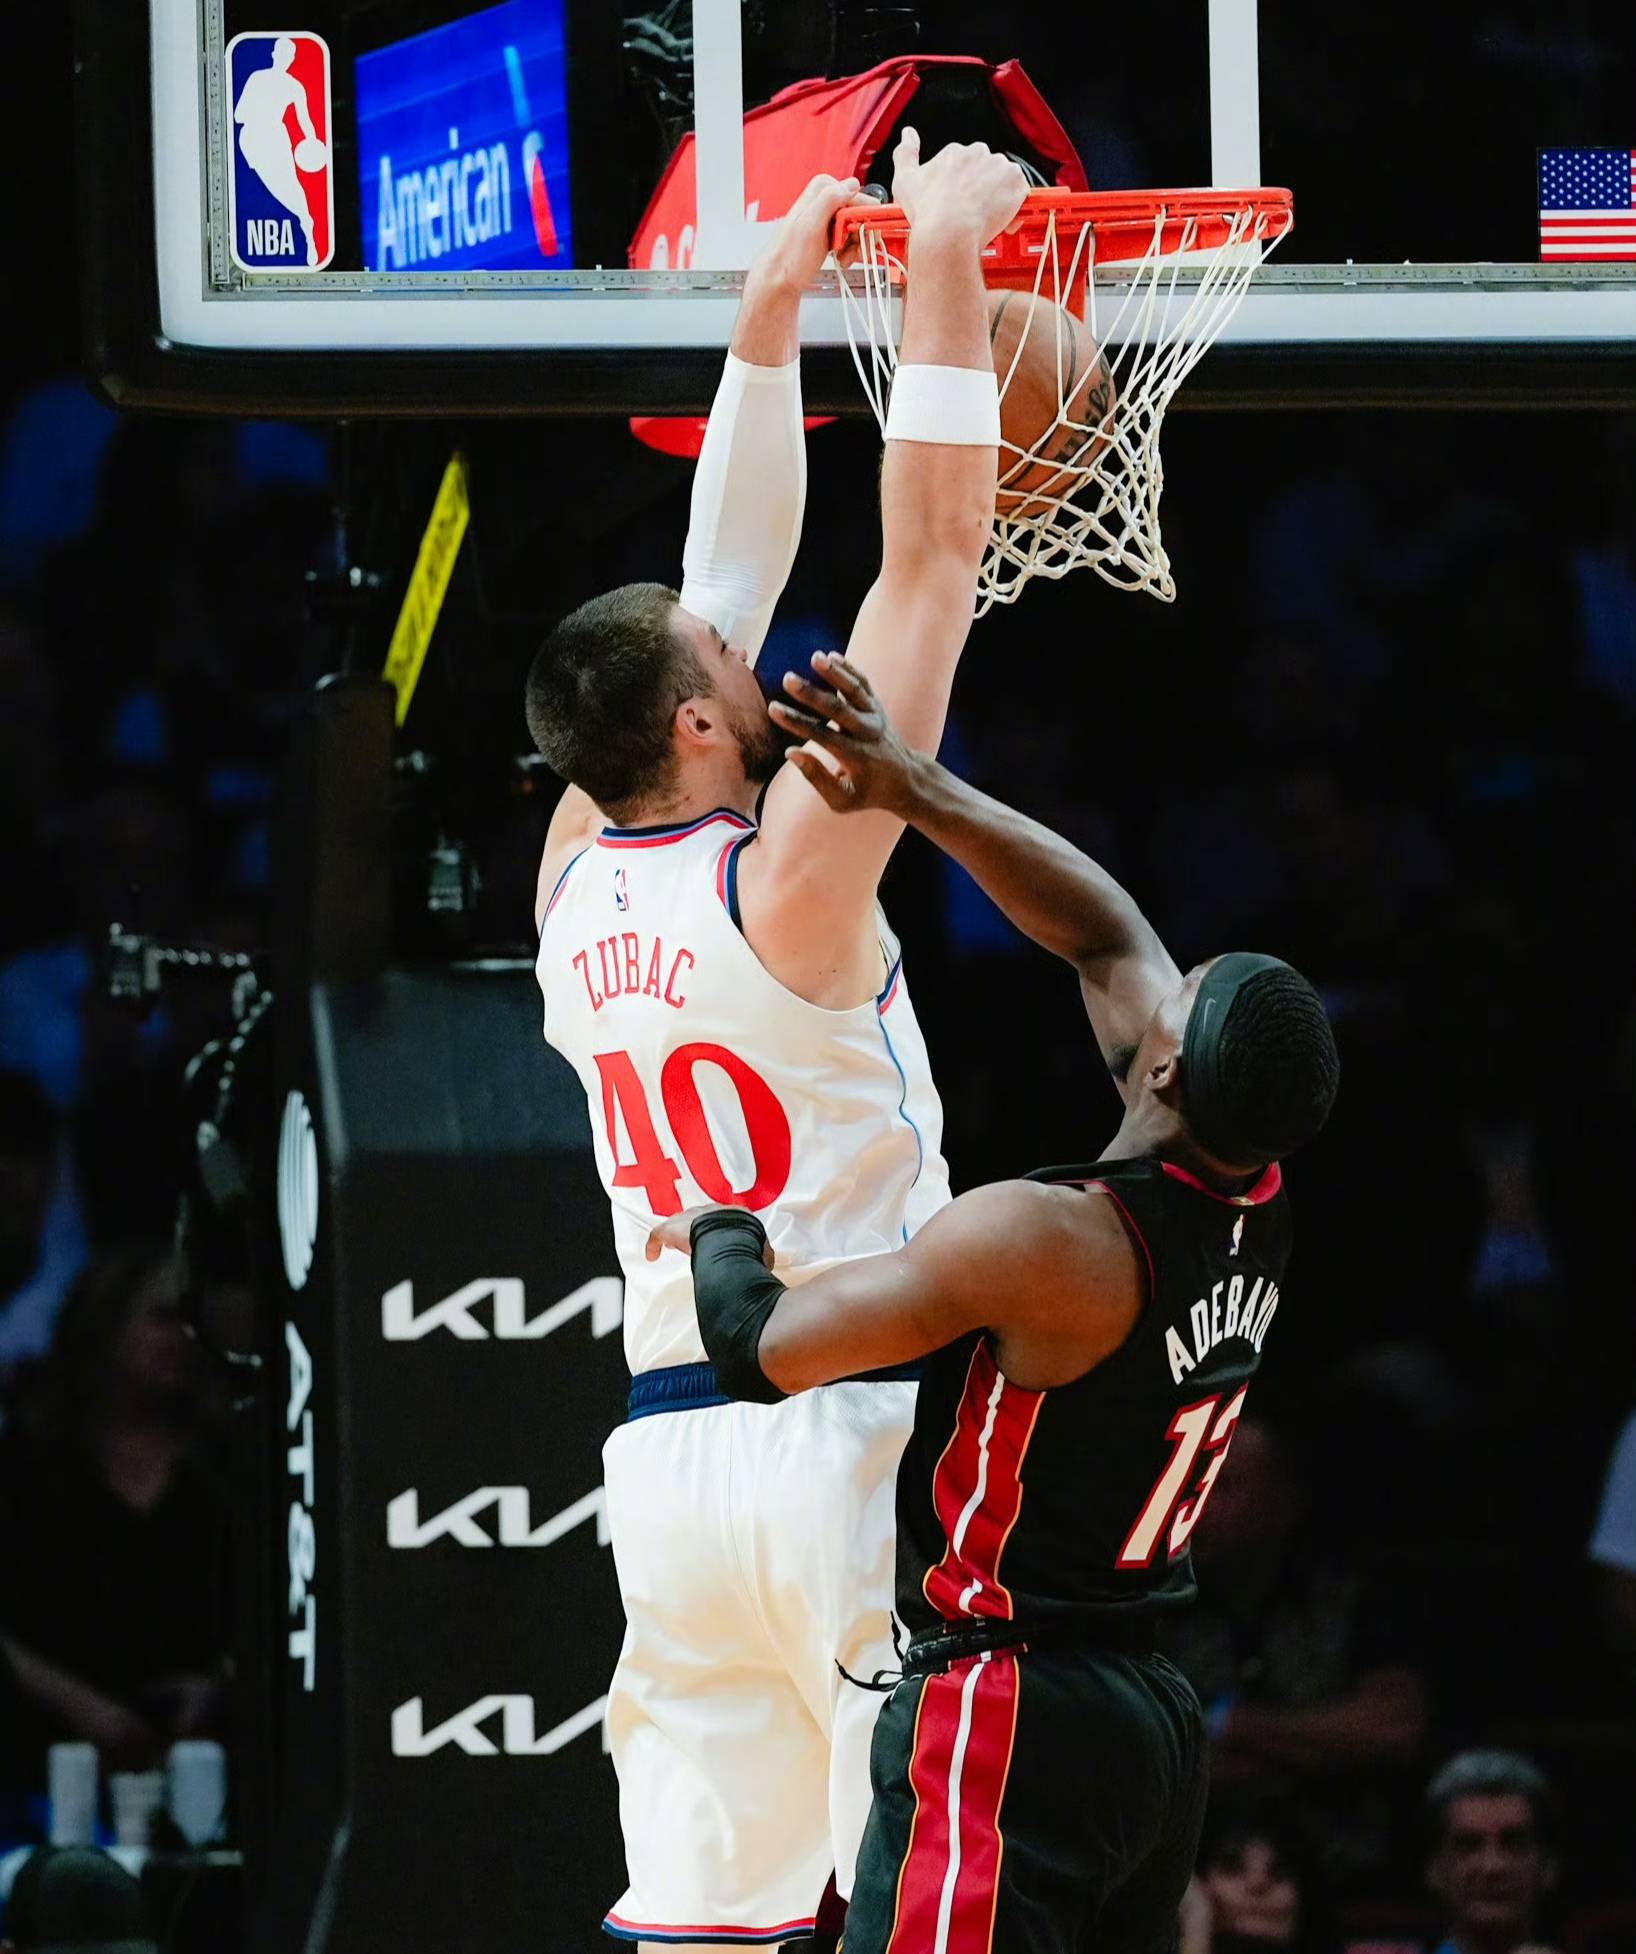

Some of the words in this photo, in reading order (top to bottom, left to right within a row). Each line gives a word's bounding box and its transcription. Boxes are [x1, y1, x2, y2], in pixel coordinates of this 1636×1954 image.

[246, 218, 296, 256] NBA
[377, 126, 512, 272] American
[572, 932, 695, 1012] ZUBAC
[593, 1042, 792, 1217] 40
[381, 1276, 624, 1341] KIA
[1164, 1274, 1280, 1385] ADEBAYO
[285, 1320, 317, 1693] AT&T
[1114, 1382, 1249, 1569] 13
